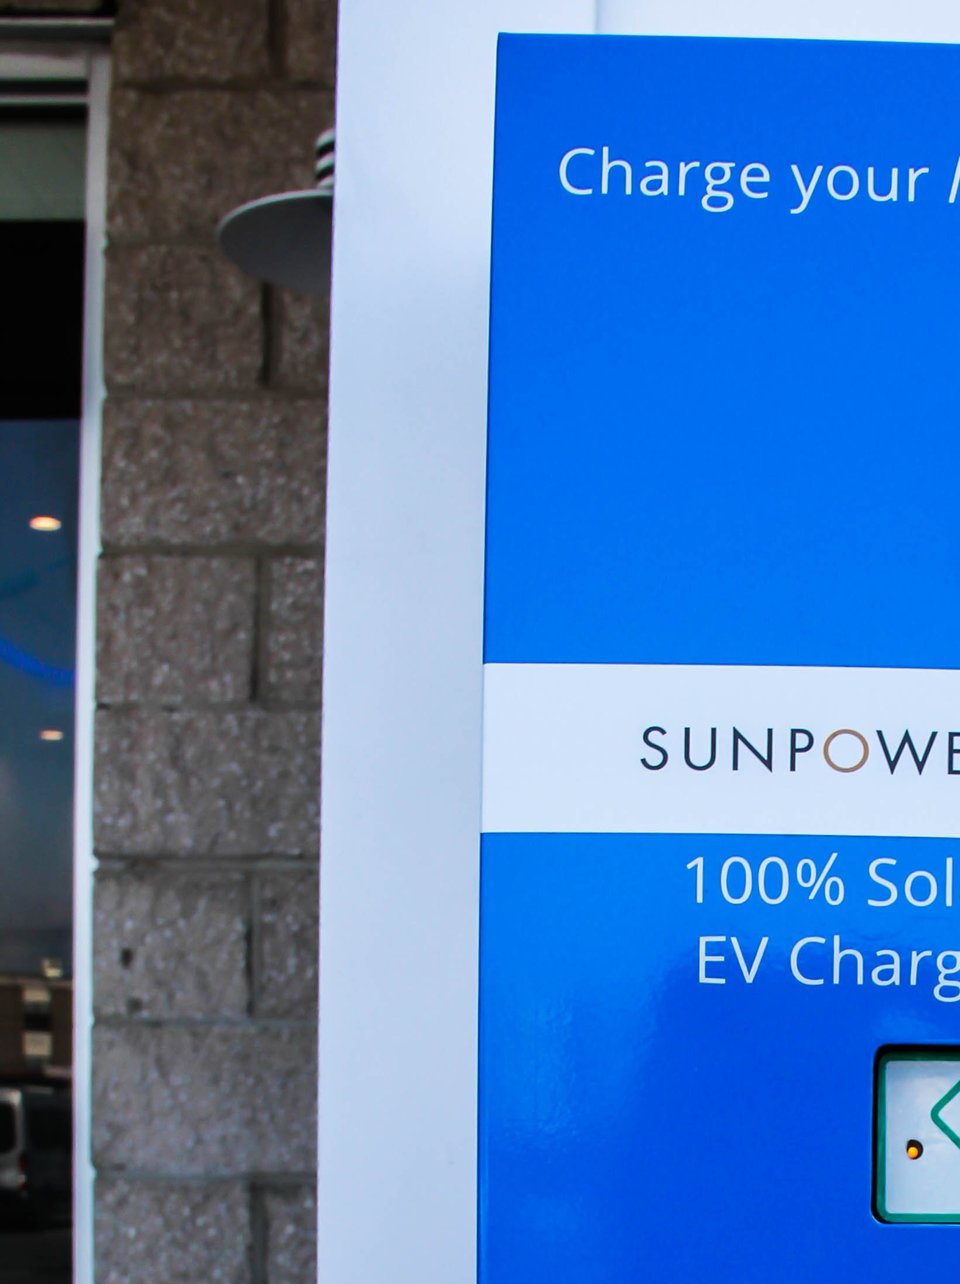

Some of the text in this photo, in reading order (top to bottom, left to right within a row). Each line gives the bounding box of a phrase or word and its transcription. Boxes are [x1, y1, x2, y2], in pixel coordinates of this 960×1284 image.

[559, 146, 770, 213] Charge
[790, 164, 930, 214] your
[686, 852, 845, 906] 100%
[698, 935, 769, 984] EV
